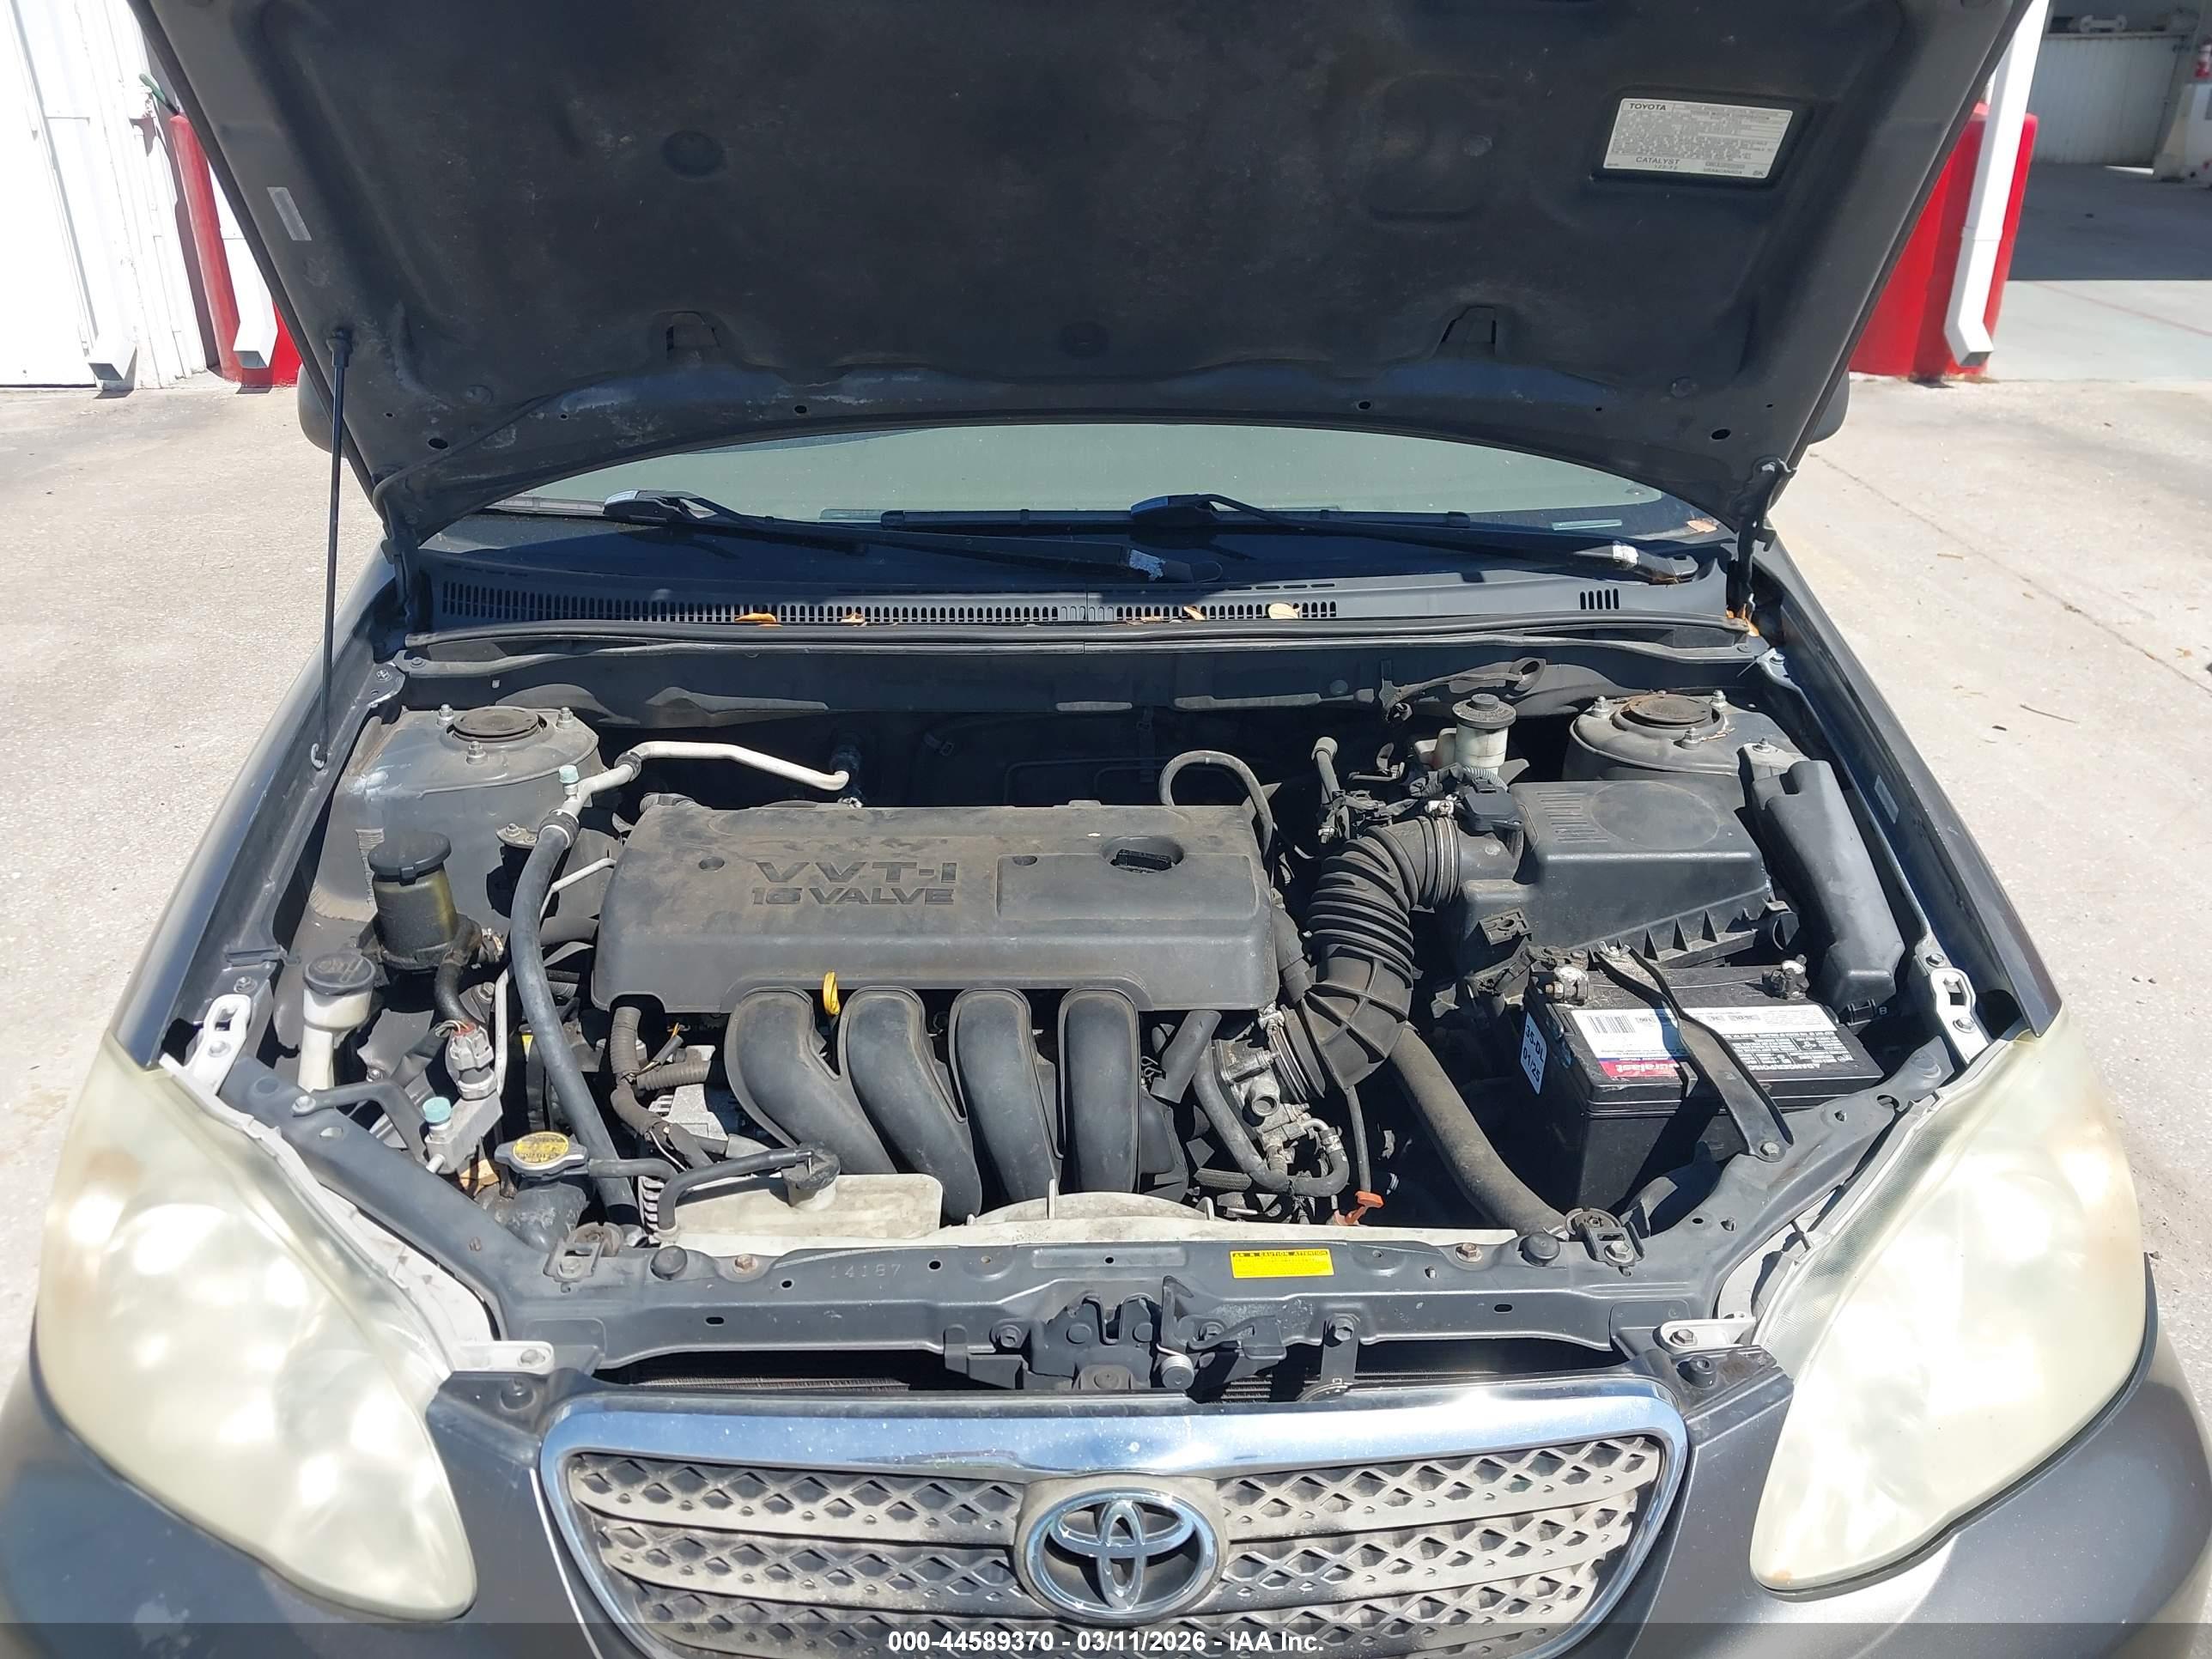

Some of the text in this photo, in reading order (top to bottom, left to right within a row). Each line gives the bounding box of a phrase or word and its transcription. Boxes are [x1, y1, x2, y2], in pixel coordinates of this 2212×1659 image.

[1629, 102, 1667, 111] TOYOTA
[1636, 156, 1680, 166] CATALYST
[752, 887, 955, 906] 16 VALVE
[1526, 1024, 1545, 1064] 35-DL
[1522, 1047, 1541, 1083] 01/25
